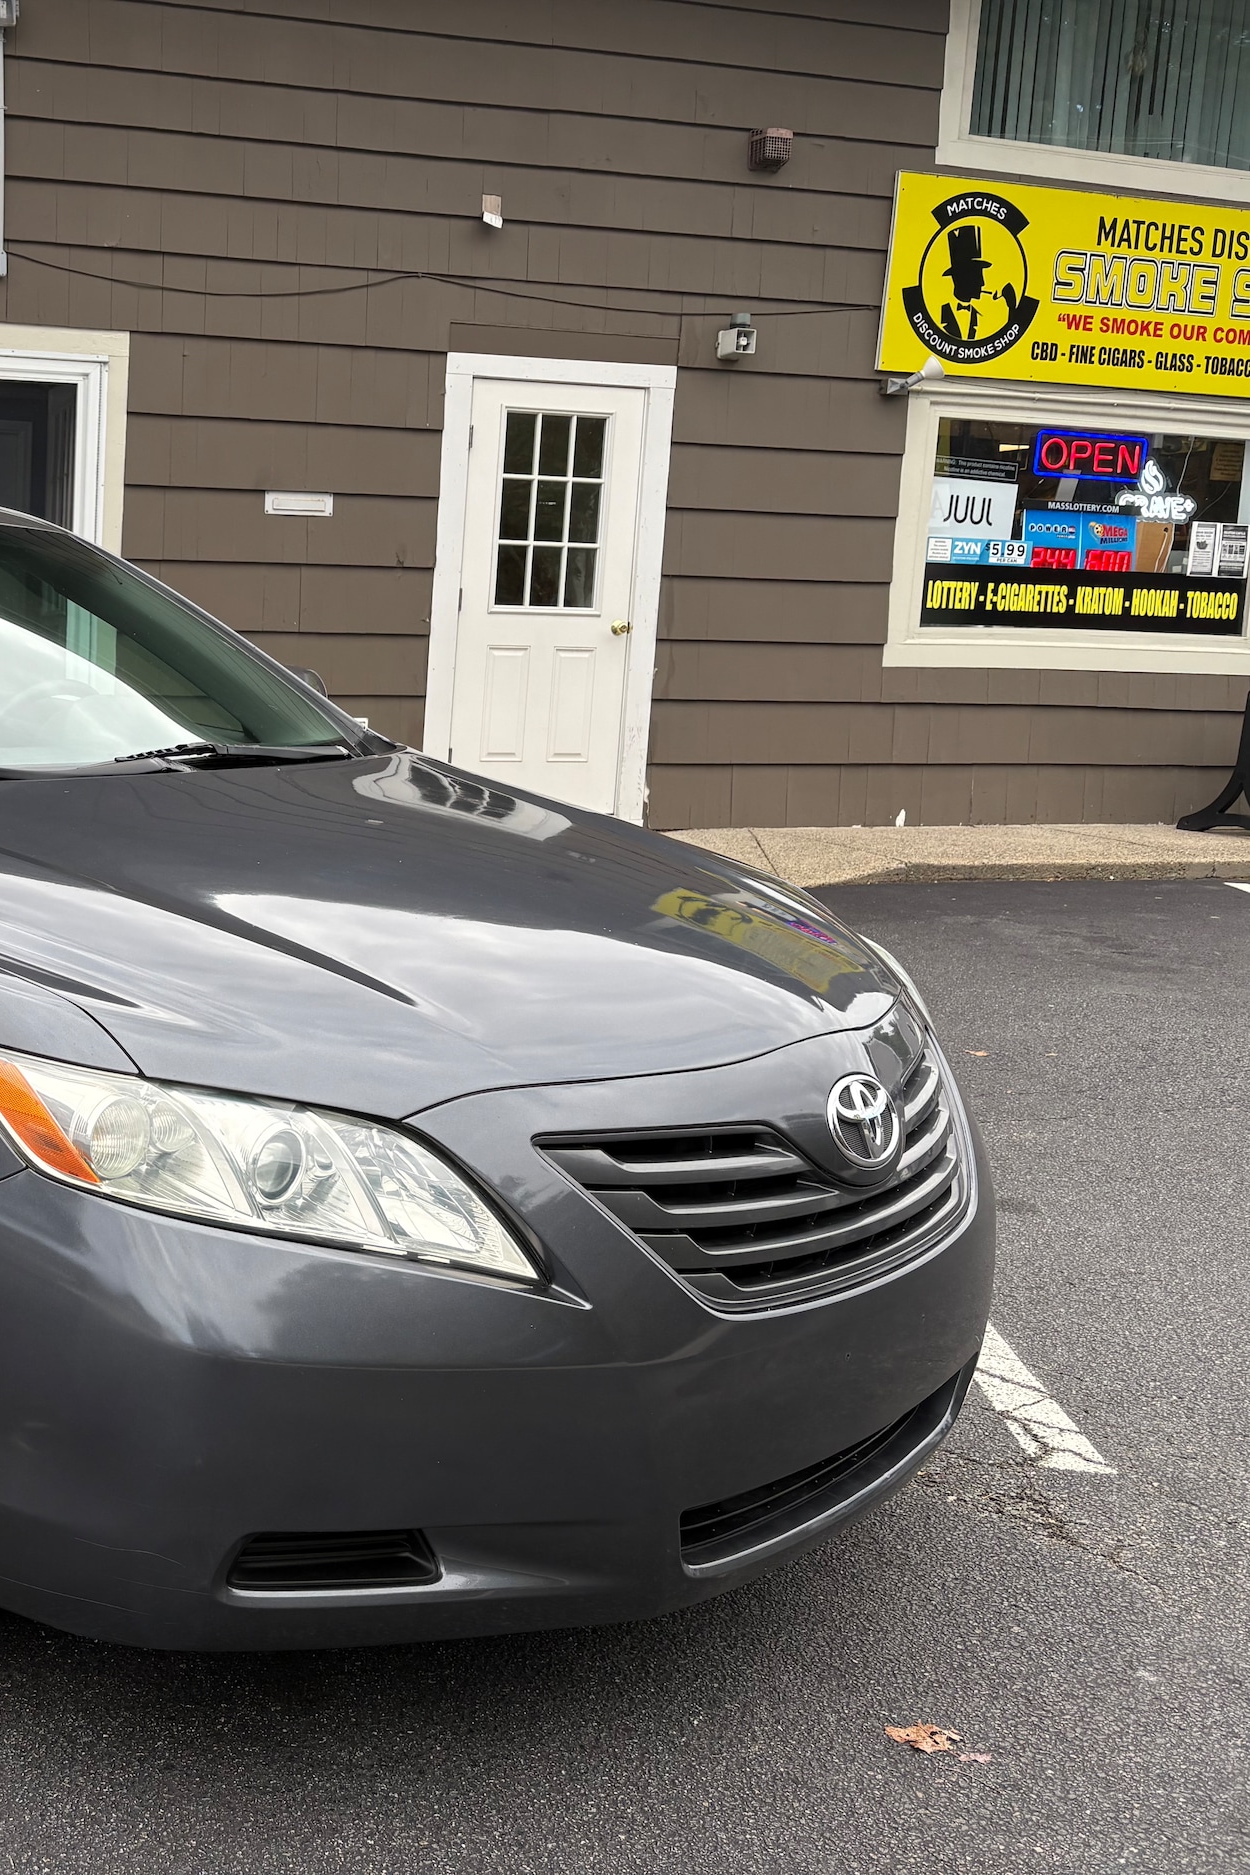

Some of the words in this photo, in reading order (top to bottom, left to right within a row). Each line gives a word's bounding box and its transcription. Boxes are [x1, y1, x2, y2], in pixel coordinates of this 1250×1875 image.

[946, 197, 1007, 220] MATCHES
[1097, 216, 1205, 257] MATCHES
[1211, 228, 1250, 261] DIS
[1051, 249, 1222, 318] SMOKE
[913, 312, 957, 355] DISCOUNT
[957, 339, 996, 359] SMOKE
[993, 324, 1021, 354] SHOP
[1100, 316, 1163, 338] SMOKE
[1169, 323, 1208, 342] OUR
[1213, 327, 1250, 346] COM
[1031, 341, 1058, 362] CBD
[1068, 344, 1096, 365] FINE
[1099, 346, 1145, 369] CIGARS
[1155, 351, 1194, 373] GLASS
[1204, 355, 1250, 377] TOBACC
[1040, 437, 1140, 475] OPEN
[943, 494, 993, 527] JUUL
[1048, 501, 1120, 513] MASSLOTTERY.COM
[954, 541, 981, 555] ZYN
[1103, 524, 1128, 538] MEGA
[926, 579, 979, 610] LOTTERY
[985, 583, 1068, 614] E-CIGARETTES
[1075, 586, 1125, 616] KRATOM
[1131, 588, 1179, 618] HOOKAH
[1186, 591, 1239, 620] TOBACCO
